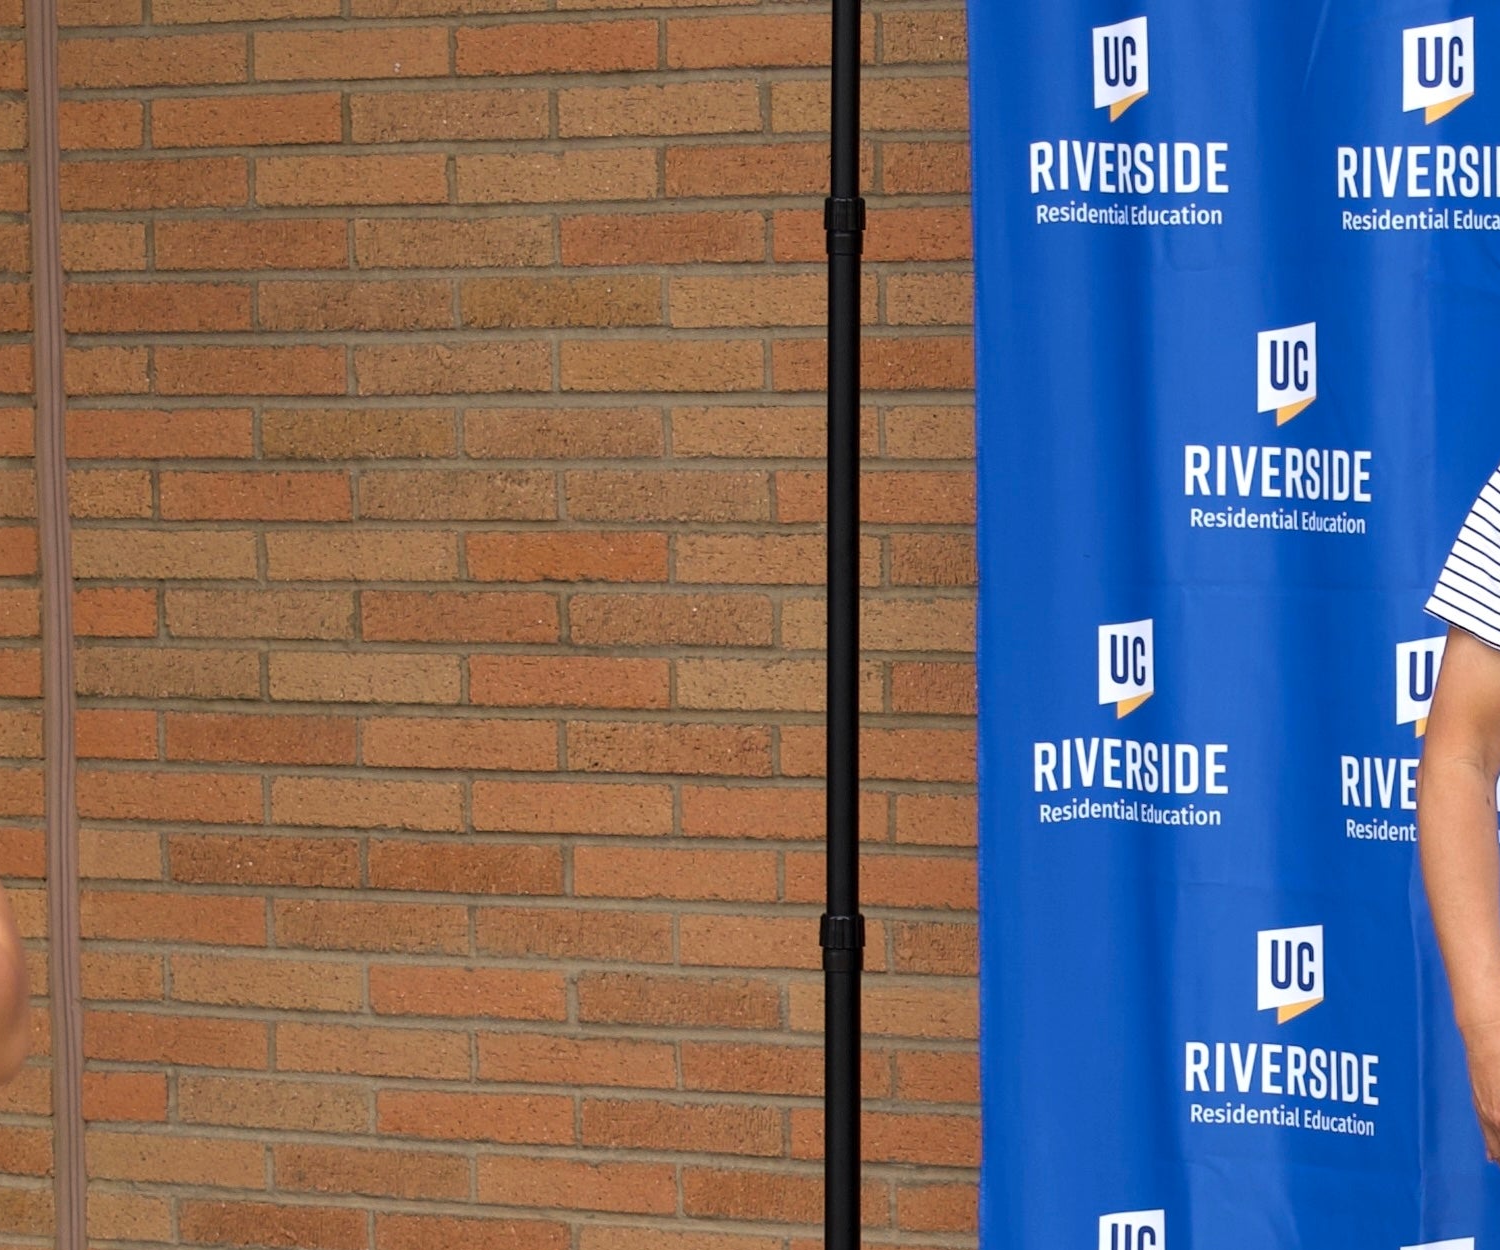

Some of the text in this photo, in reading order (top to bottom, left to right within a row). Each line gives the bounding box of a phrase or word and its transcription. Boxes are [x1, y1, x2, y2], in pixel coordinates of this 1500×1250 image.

[1103, 35, 1137, 88] UC
[1417, 35, 1464, 89] UC
[1030, 140, 1228, 193] RIVERSIDE
[1037, 203, 1222, 225] Residential Education
[1343, 208, 1448, 230] Residential
[1270, 339, 1309, 392] UC
[1185, 445, 1371, 501] RIVERSIDE
[1191, 506, 1365, 534] Residential Education
[1110, 634, 1146, 687] UC
[1409, 651, 1434, 702] U
[1035, 738, 1228, 794] RIVERSIDE
[1040, 798, 1221, 825] Residential Education
[1346, 819, 1417, 841] Resident
[1270, 939, 1315, 992] UC
[1186, 1042, 1378, 1104] RIVERSIDE
[1191, 1102, 1374, 1136] Residential Education
